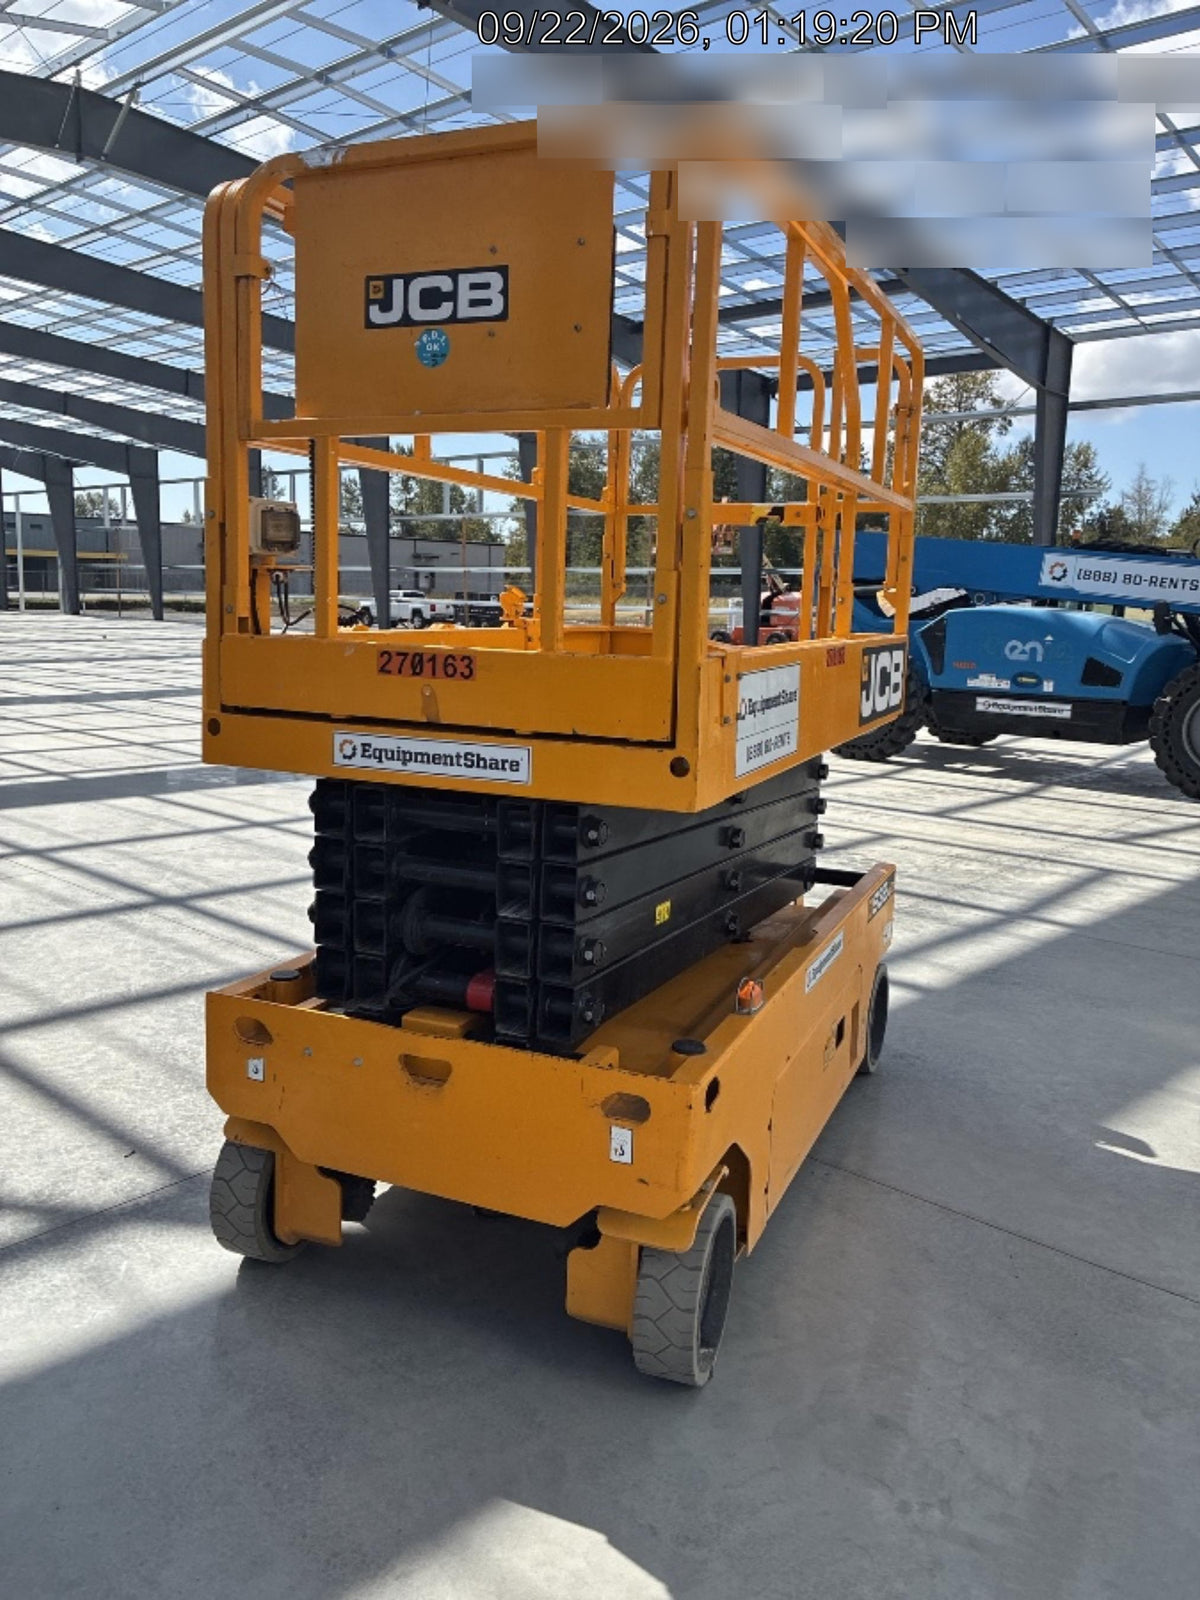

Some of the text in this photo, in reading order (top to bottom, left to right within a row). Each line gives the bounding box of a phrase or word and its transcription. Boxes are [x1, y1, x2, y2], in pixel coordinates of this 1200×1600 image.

[368, 270, 505, 325] JCB
[1077, 567, 1200, 592] (888) 80-RENTS
[378, 650, 475, 680] 270163
[860, 649, 904, 718] JCB
[360, 742, 521, 773] EquipmentShare
